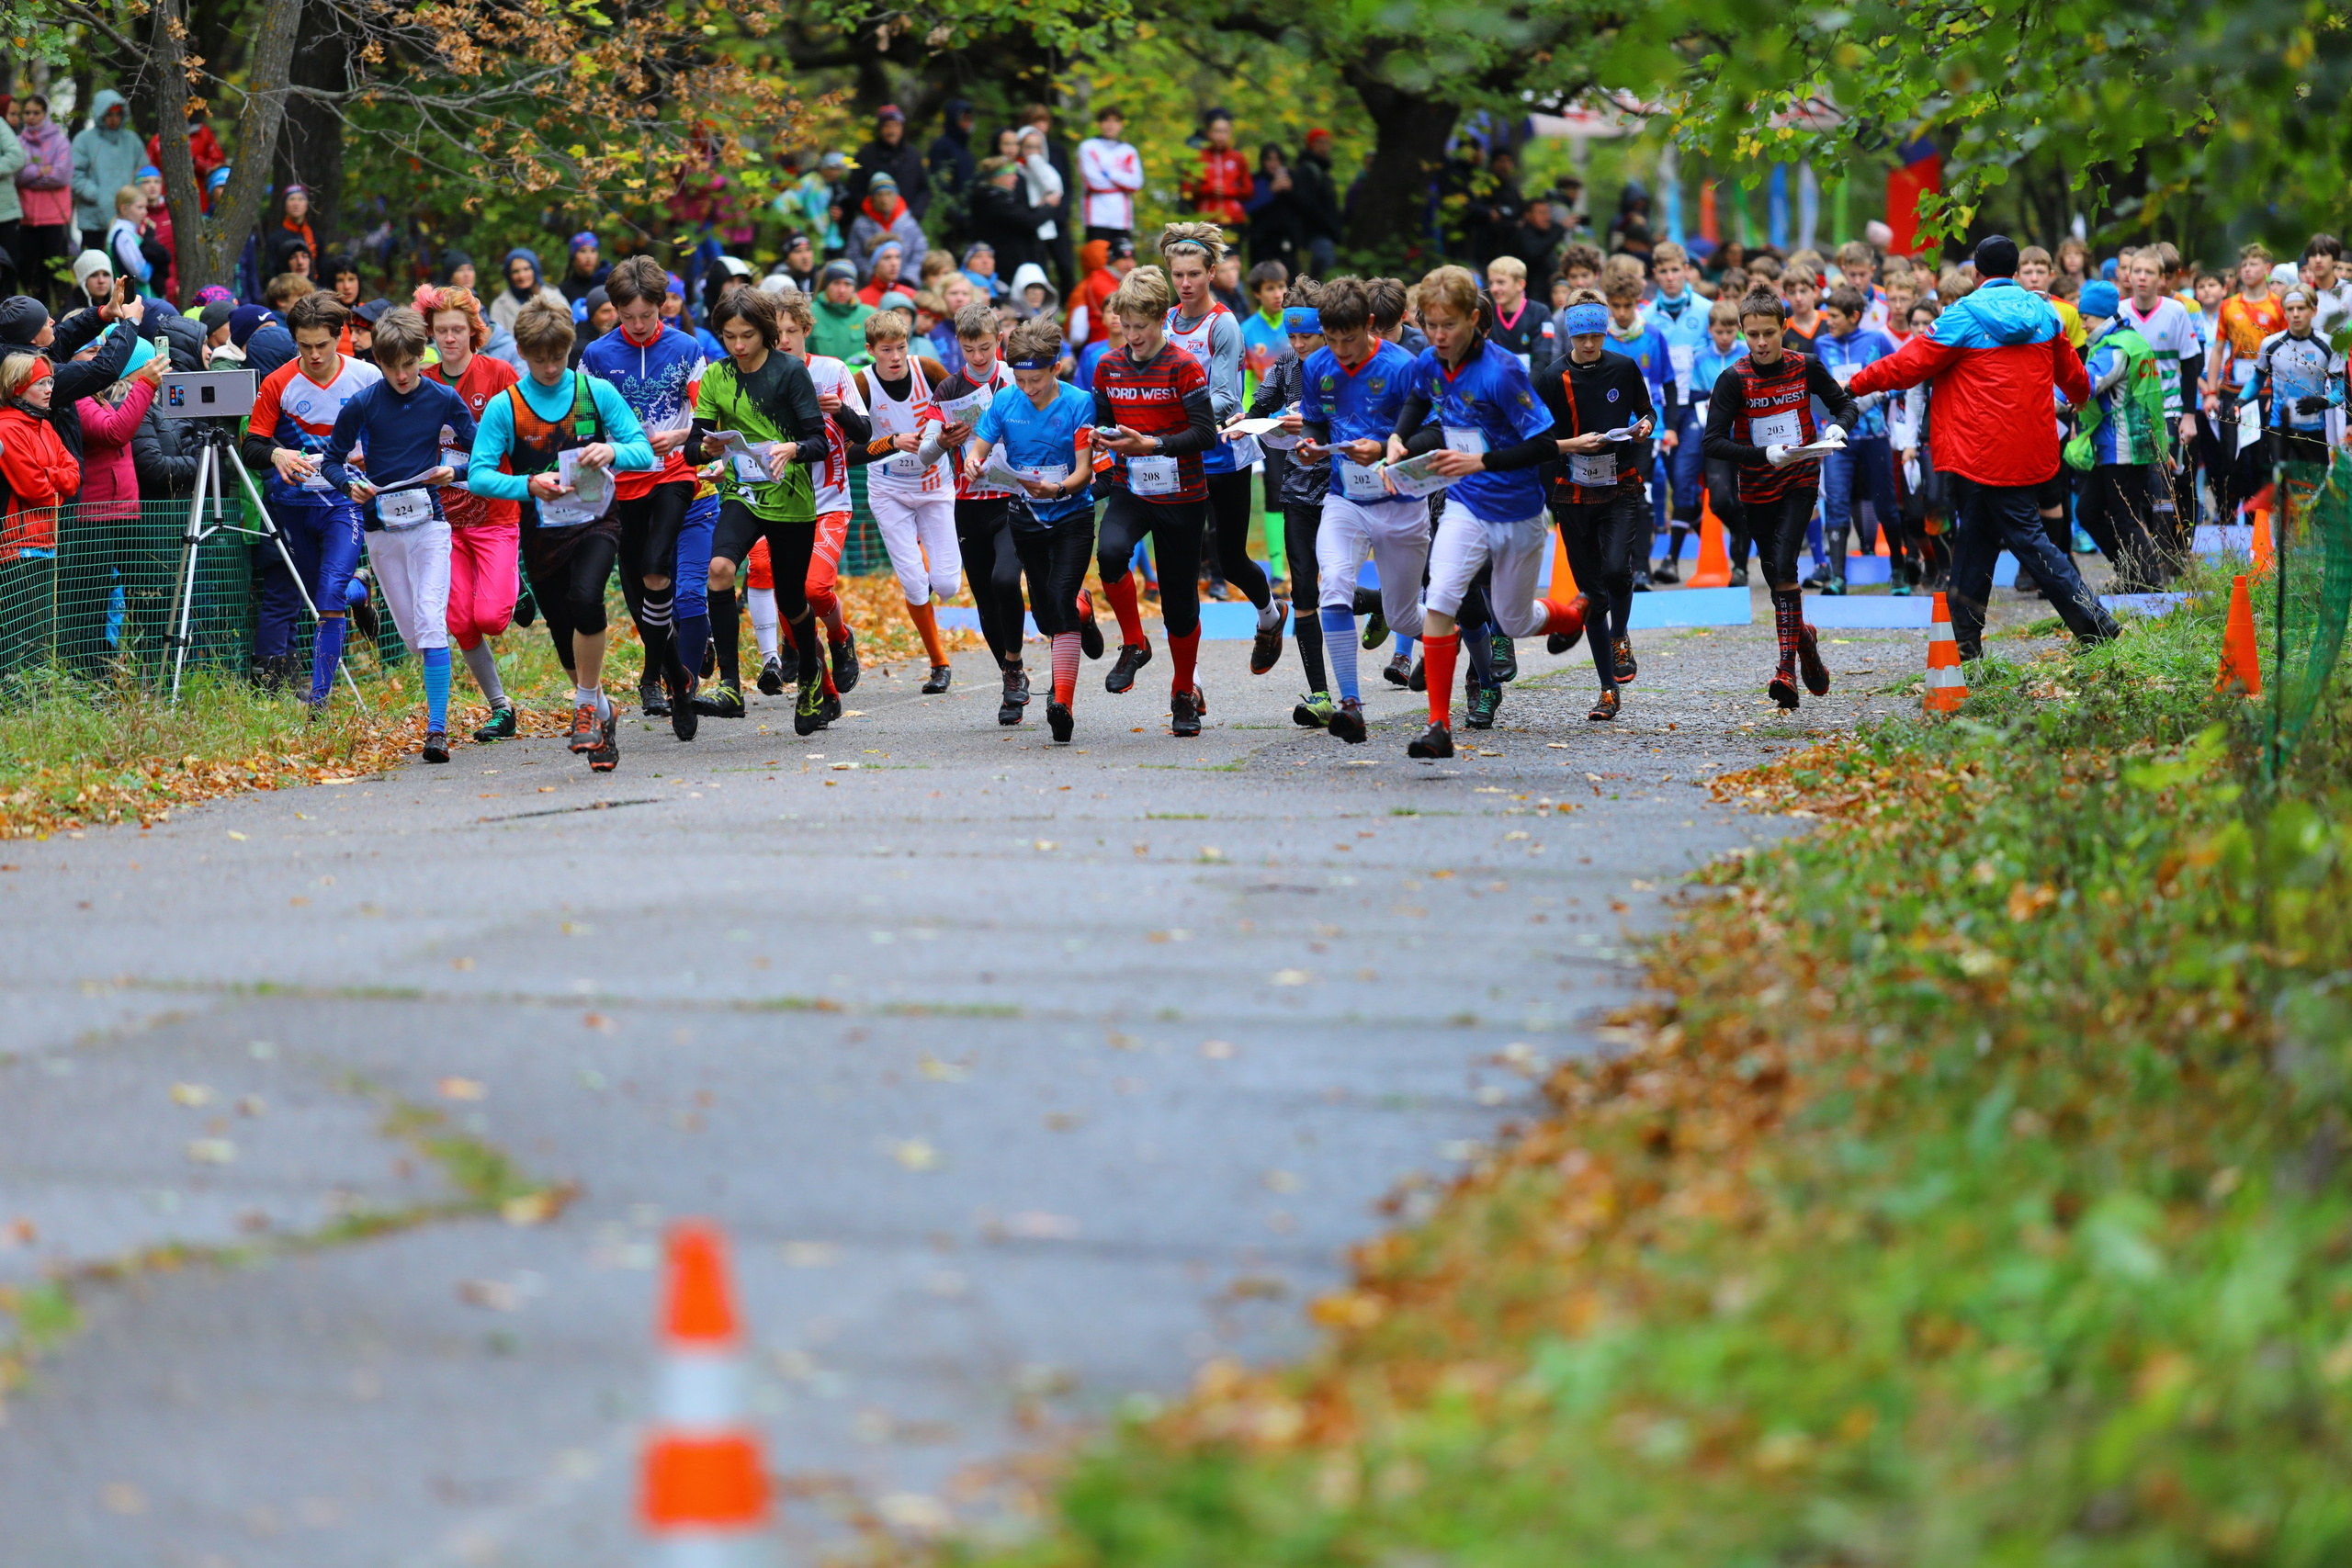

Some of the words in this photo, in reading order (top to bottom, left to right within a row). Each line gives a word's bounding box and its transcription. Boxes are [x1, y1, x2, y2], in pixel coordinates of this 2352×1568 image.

[1106, 387, 1137, 400] NORD
[1141, 387, 1177, 400] WEST
[1772, 389, 1805, 406] WEST
[1767, 425, 1785, 435] 203
[831, 454, 844, 482] think
[1582, 468, 1599, 477] 204
[1142, 471, 1160, 481] 208
[1353, 474, 1372, 484] 202
[394, 504, 413, 516] 224
[1780, 596, 1789, 624] WEST
